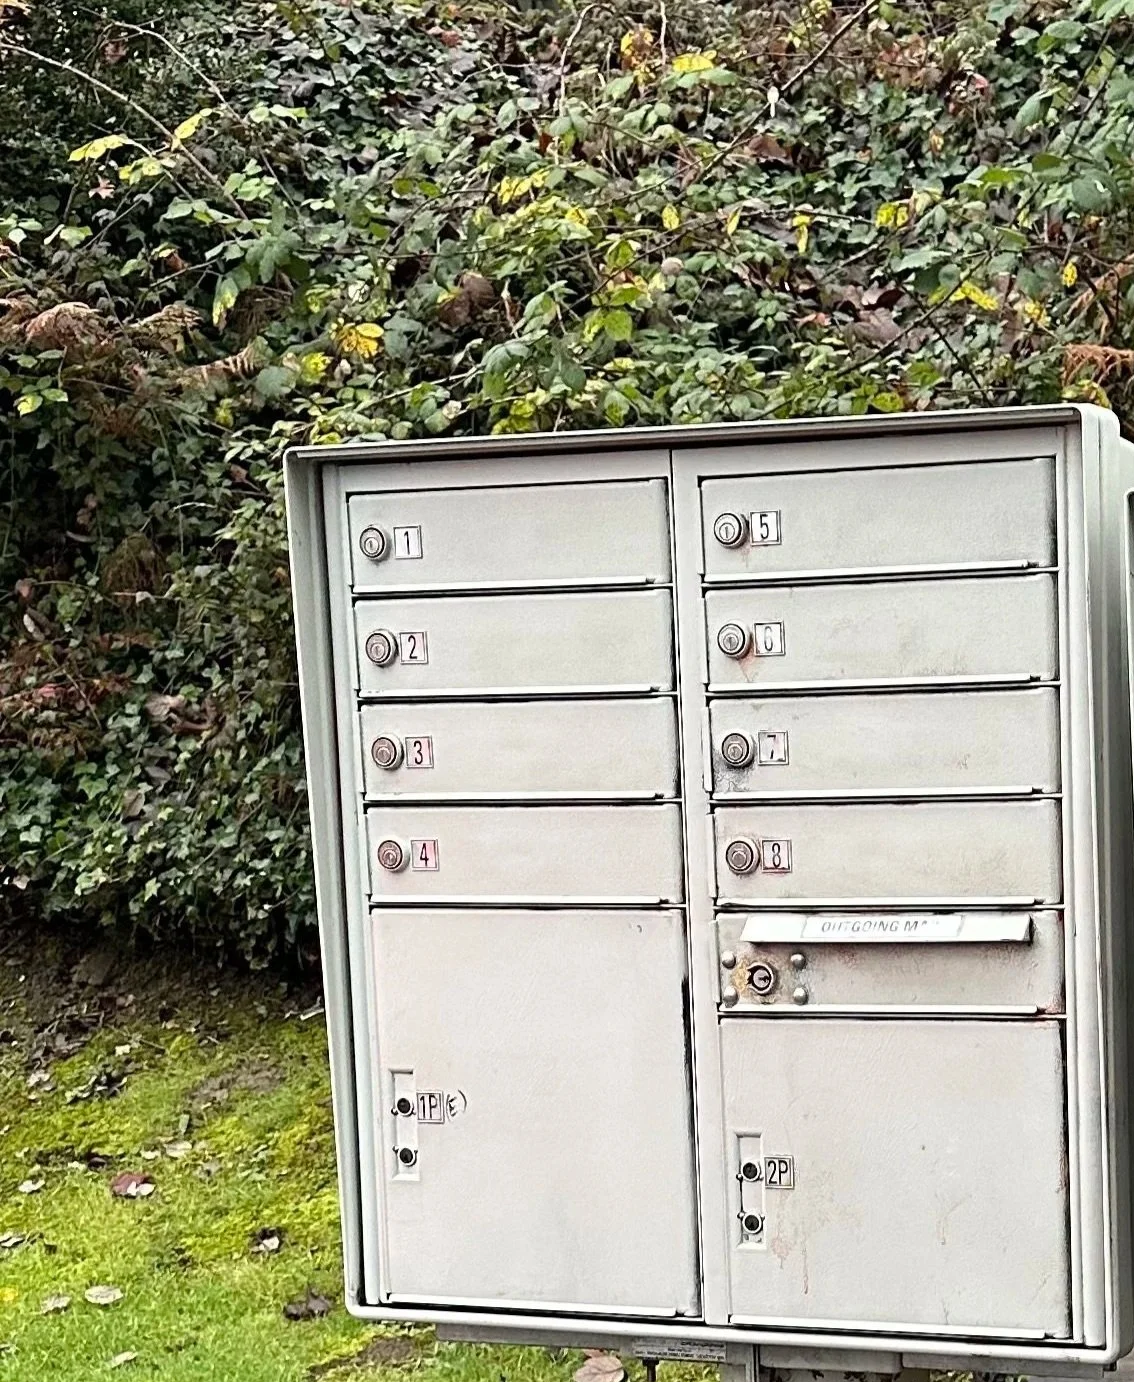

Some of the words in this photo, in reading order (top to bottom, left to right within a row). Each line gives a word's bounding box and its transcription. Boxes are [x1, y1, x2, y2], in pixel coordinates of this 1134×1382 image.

[758, 516, 769, 539] 5
[404, 531, 411, 554] 1
[408, 636, 418, 659] 2
[764, 626, 773, 651] 6
[414, 741, 424, 764] 3
[767, 735, 777, 759] 7
[420, 843, 430, 866] 4
[772, 844, 781, 867] 8
[420, 1094, 438, 1118] 1P
[767, 1159, 790, 1186] 2P
